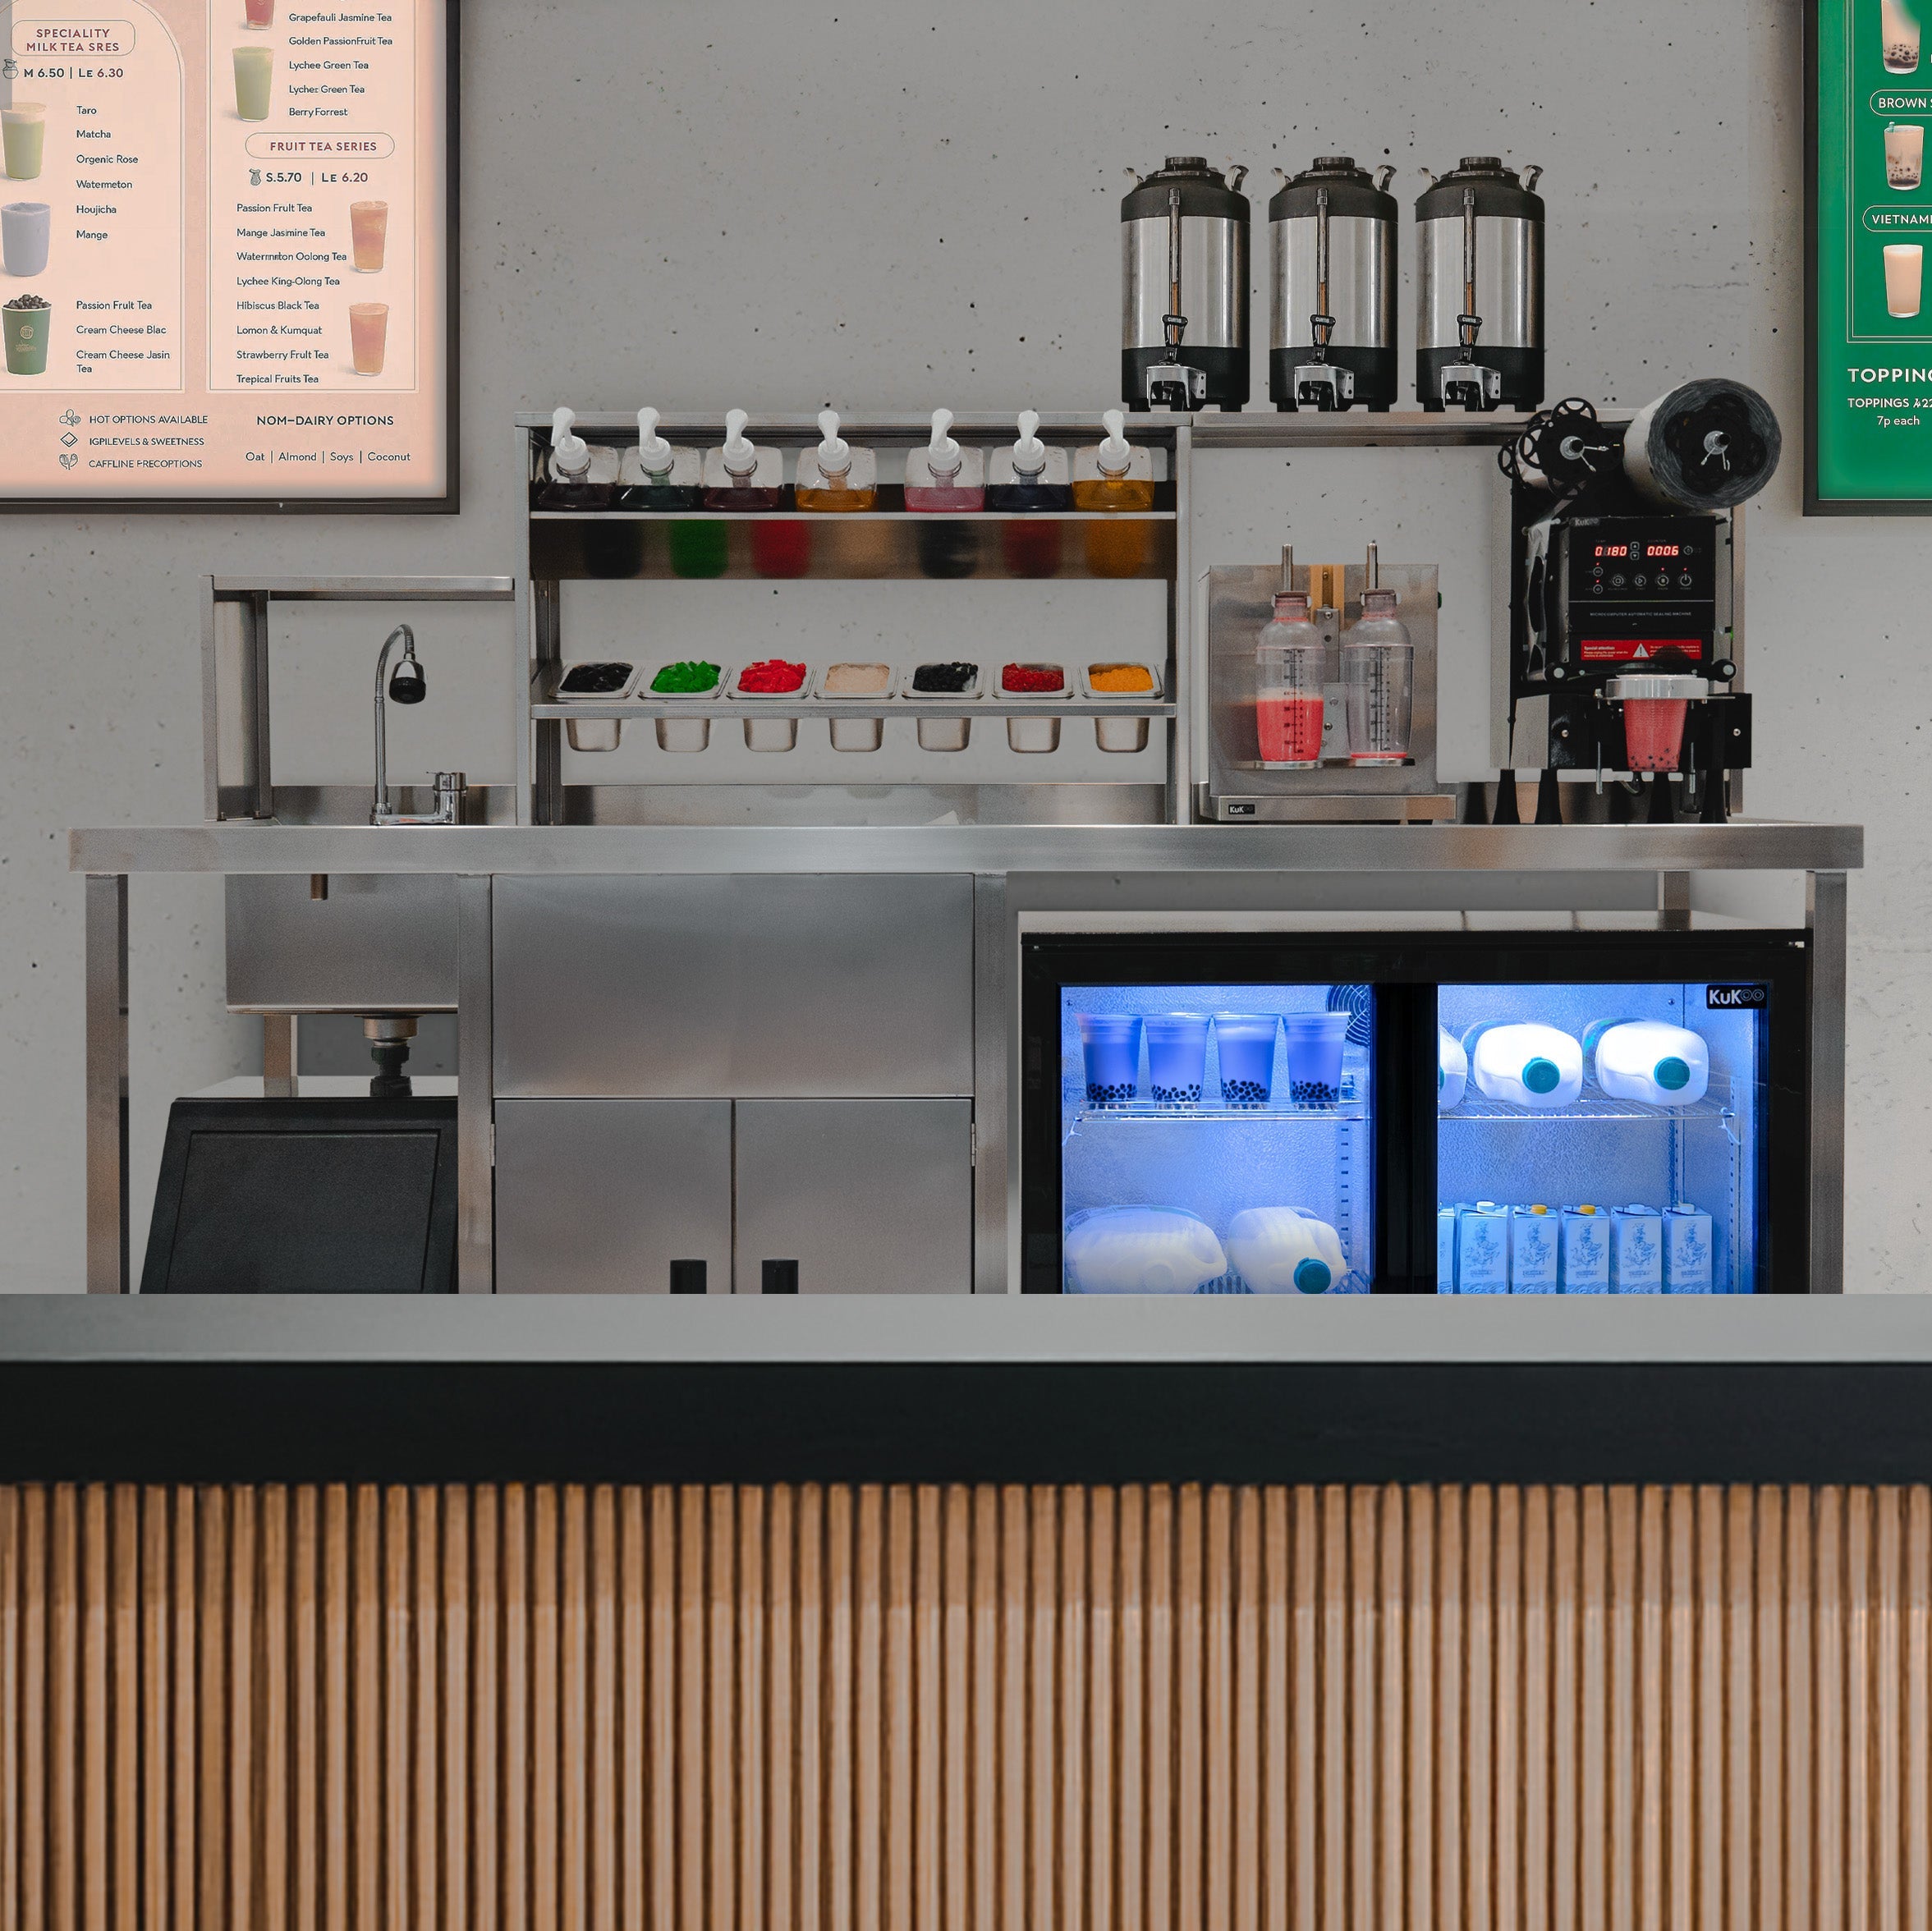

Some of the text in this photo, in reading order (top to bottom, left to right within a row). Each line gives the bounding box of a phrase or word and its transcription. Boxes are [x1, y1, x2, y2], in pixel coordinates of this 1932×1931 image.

[337, 13, 375, 21] Jasmine
[376, 13, 392, 21] Tea
[36, 29, 110, 38] SPECIALITY
[288, 36, 321, 45] Golden
[377, 37, 392, 45] Tea
[26, 43, 119, 52] MILK TEA SRES
[289, 61, 369, 71] Lychee Green Tea
[24, 68, 34, 78] M
[38, 68, 65, 78] 6.50
[97, 68, 123, 78] 6.30
[320, 85, 347, 94] Green
[349, 85, 365, 94] Tea
[1879, 98, 1927, 108] BROWN
[76, 105, 97, 115] Taro
[289, 108, 348, 118] Berry Forrest
[76, 130, 111, 138] Matcha
[270, 142, 377, 151] FRUIT TEA SERIES
[117, 154, 138, 163] Rose
[266, 172, 302, 182] S.5.70
[342, 172, 369, 182] 6.20
[76, 204, 117, 216] Houjicha
[236, 204, 271, 212] Passion
[296, 204, 312, 212] Tea
[76, 231, 108, 241] Mange
[236, 228, 268, 238] Mange
[310, 228, 326, 236] Tea
[296, 252, 329, 262] Oolong
[332, 252, 347, 260] Tea
[236, 277, 340, 287] Lychee King-Olong Tea
[76, 300, 110, 310] Passion
[136, 300, 152, 310] Tea
[236, 300, 319, 310] Hibiscus Black Tea
[76, 325, 167, 334] Cream Cheese Blac
[236, 325, 323, 336] Lomon & Kumquat
[76, 350, 170, 359] Cream Cheese Jasin
[236, 350, 287, 360] Strawberry
[314, 350, 329, 359] Tea
[76, 364, 93, 373] Tea
[275, 374, 301, 383] Fruits
[303, 374, 319, 383] Tea
[1847, 398, 1910, 408] TOPPINGS
[89, 415, 209, 424] HOT OPTIONS AVAILABLE
[337, 415, 394, 426] OPTIONS
[1877, 415, 1920, 429] 7p each
[142, 438, 149, 446] &
[151, 438, 204, 446] SWEETNESS
[245, 452, 411, 464] Oat Almond Soys Coconut
[1647, 545, 1679, 556] 0006
